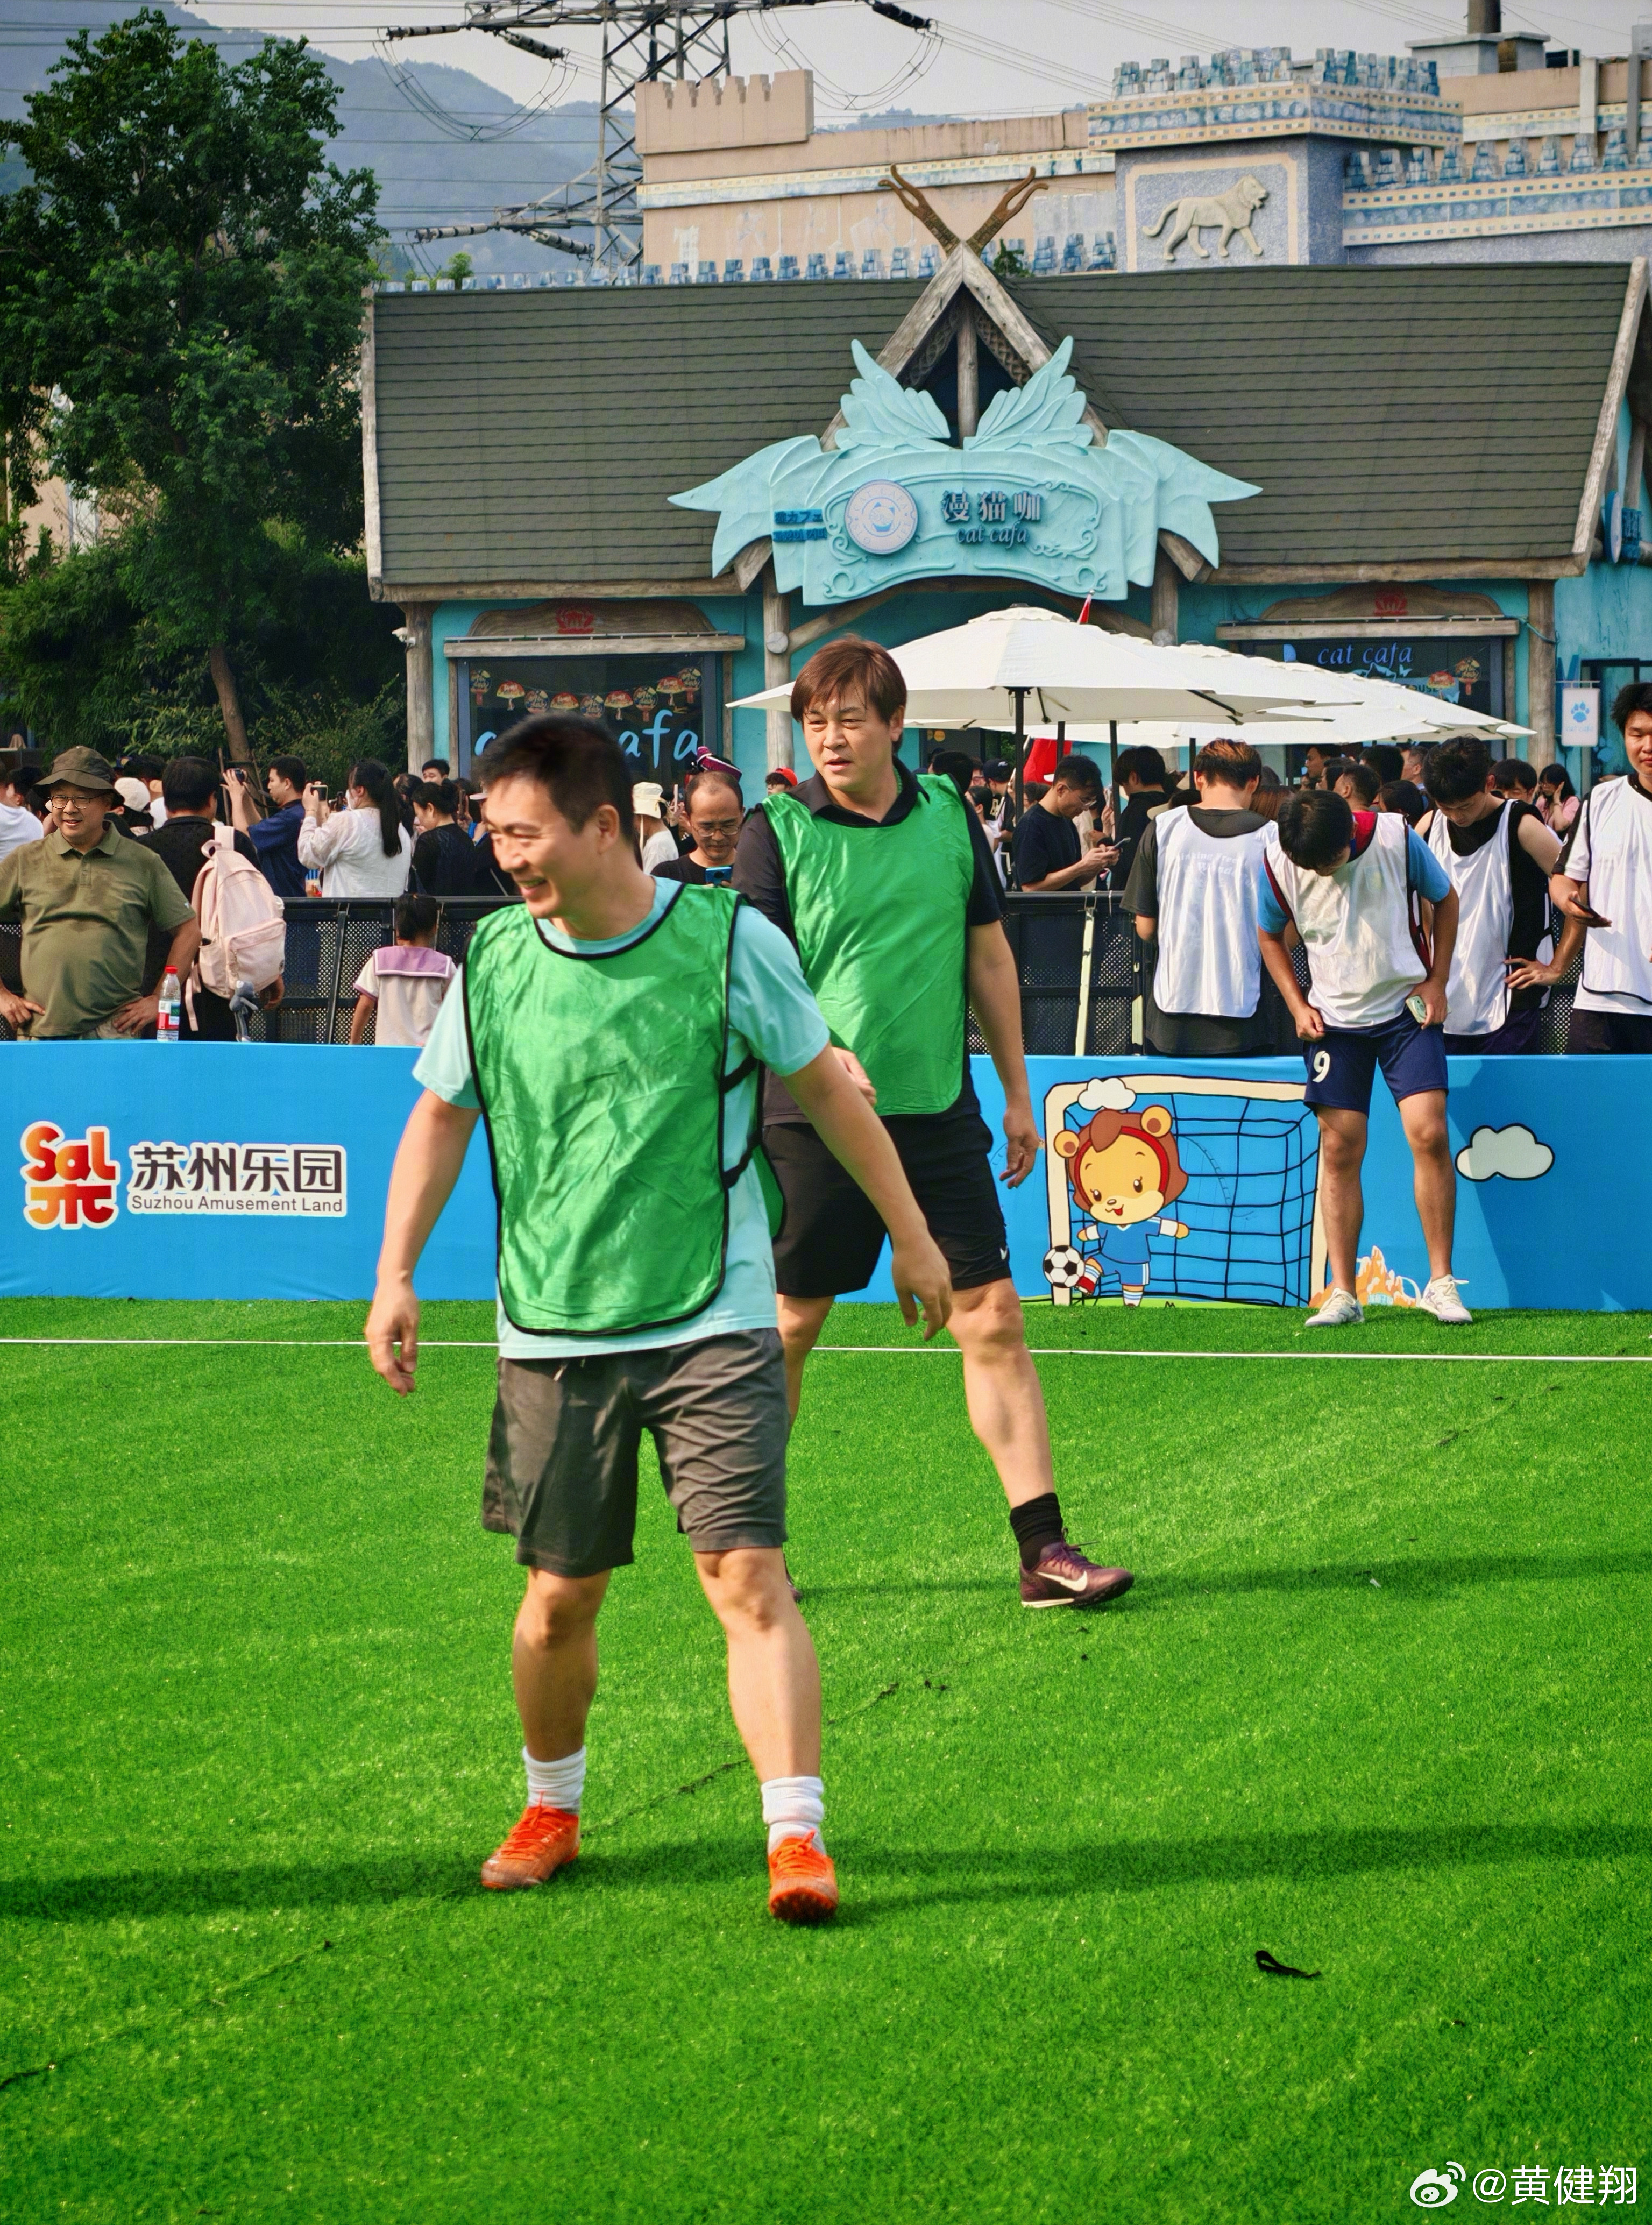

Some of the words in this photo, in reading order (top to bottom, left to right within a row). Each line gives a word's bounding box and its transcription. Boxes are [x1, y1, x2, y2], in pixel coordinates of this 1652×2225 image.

[956, 525, 983, 543] cat
[989, 519, 1029, 549] cafa
[1318, 645, 1354, 665] cat
[1362, 642, 1413, 669] cafa
[618, 709, 699, 769] afa
[1313, 1051, 1331, 1083] 9
[132, 1147, 342, 1193] 苏州乐园
[132, 1195, 194, 1210] Suzhou
[198, 1196, 297, 1211] Amusement
[302, 1197, 343, 1213] Land
